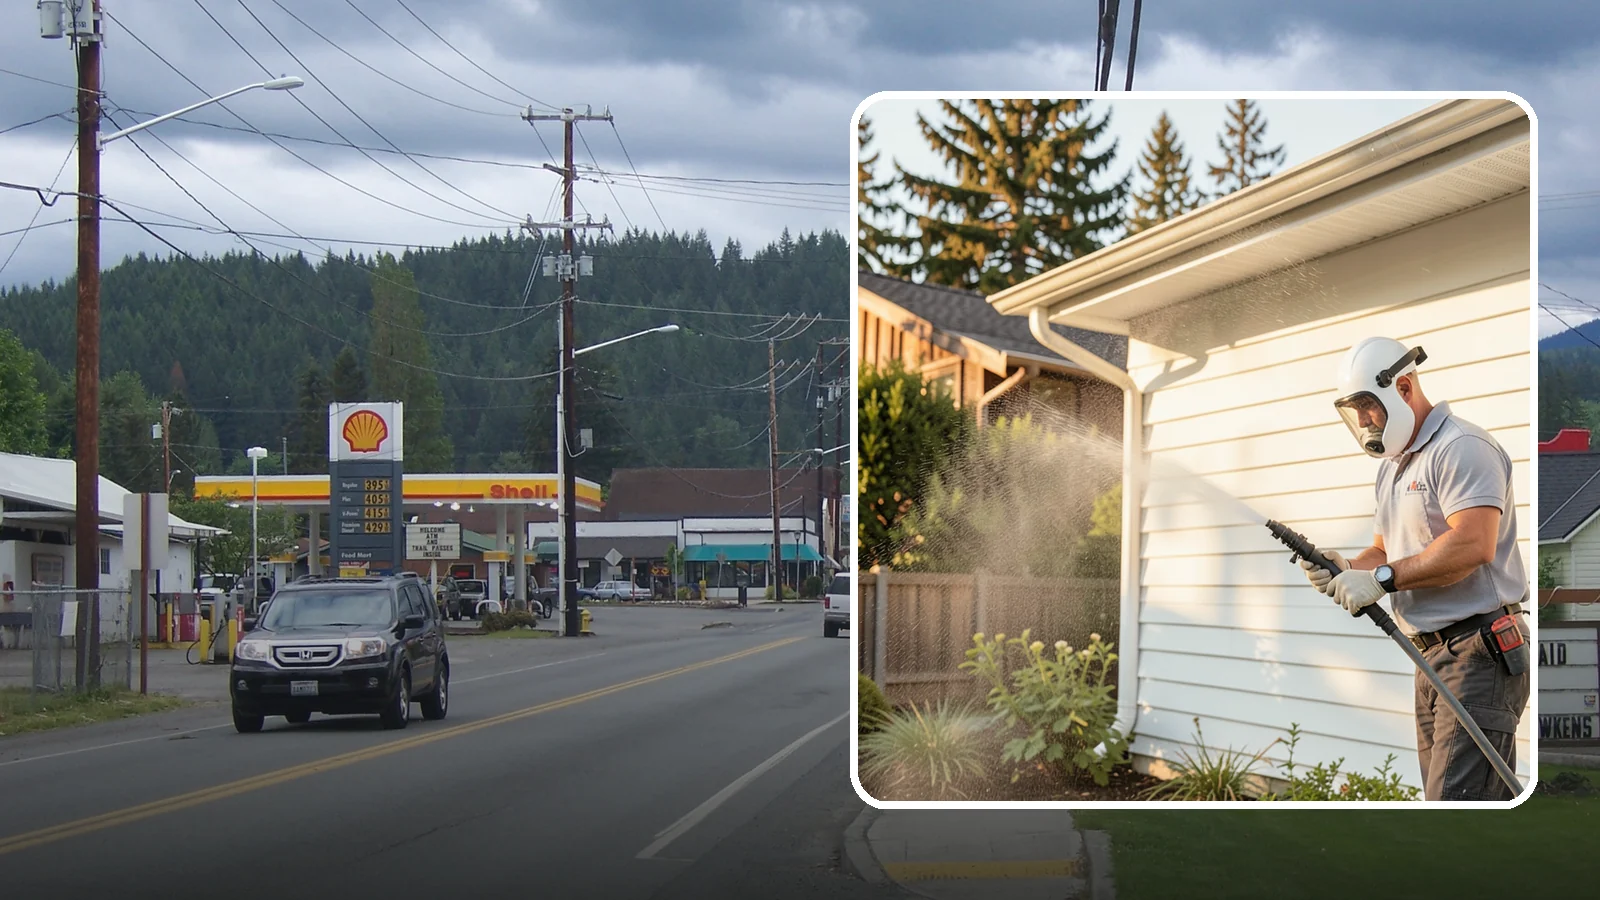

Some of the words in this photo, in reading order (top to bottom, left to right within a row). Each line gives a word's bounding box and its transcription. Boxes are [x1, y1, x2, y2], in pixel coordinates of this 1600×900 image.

[366, 480, 383, 490] 395
[490, 484, 547, 499] Shell
[366, 494, 383, 504] 405
[366, 508, 383, 518] 415
[366, 522, 383, 532] 429
